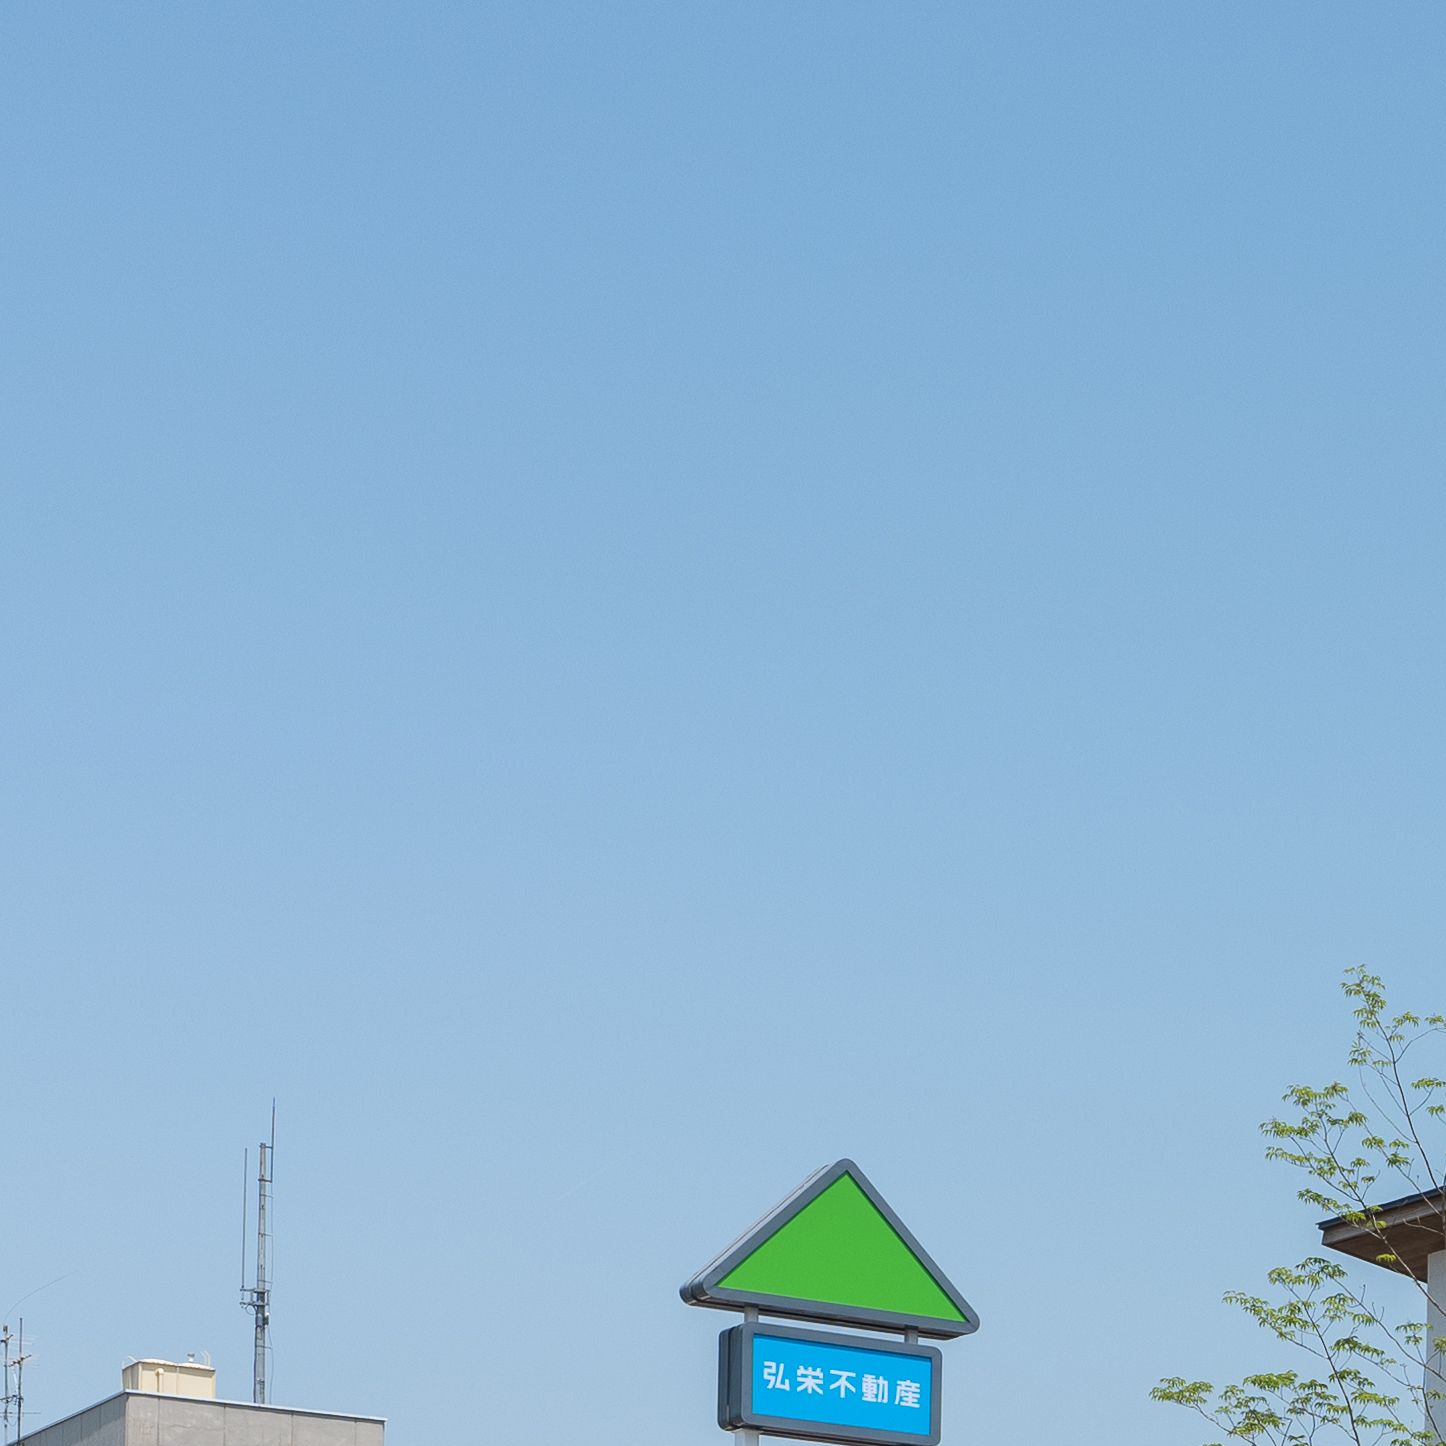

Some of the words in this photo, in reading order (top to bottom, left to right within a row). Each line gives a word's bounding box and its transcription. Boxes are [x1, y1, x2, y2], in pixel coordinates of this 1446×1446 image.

[762, 1360, 921, 1409] 弘栄不動産
